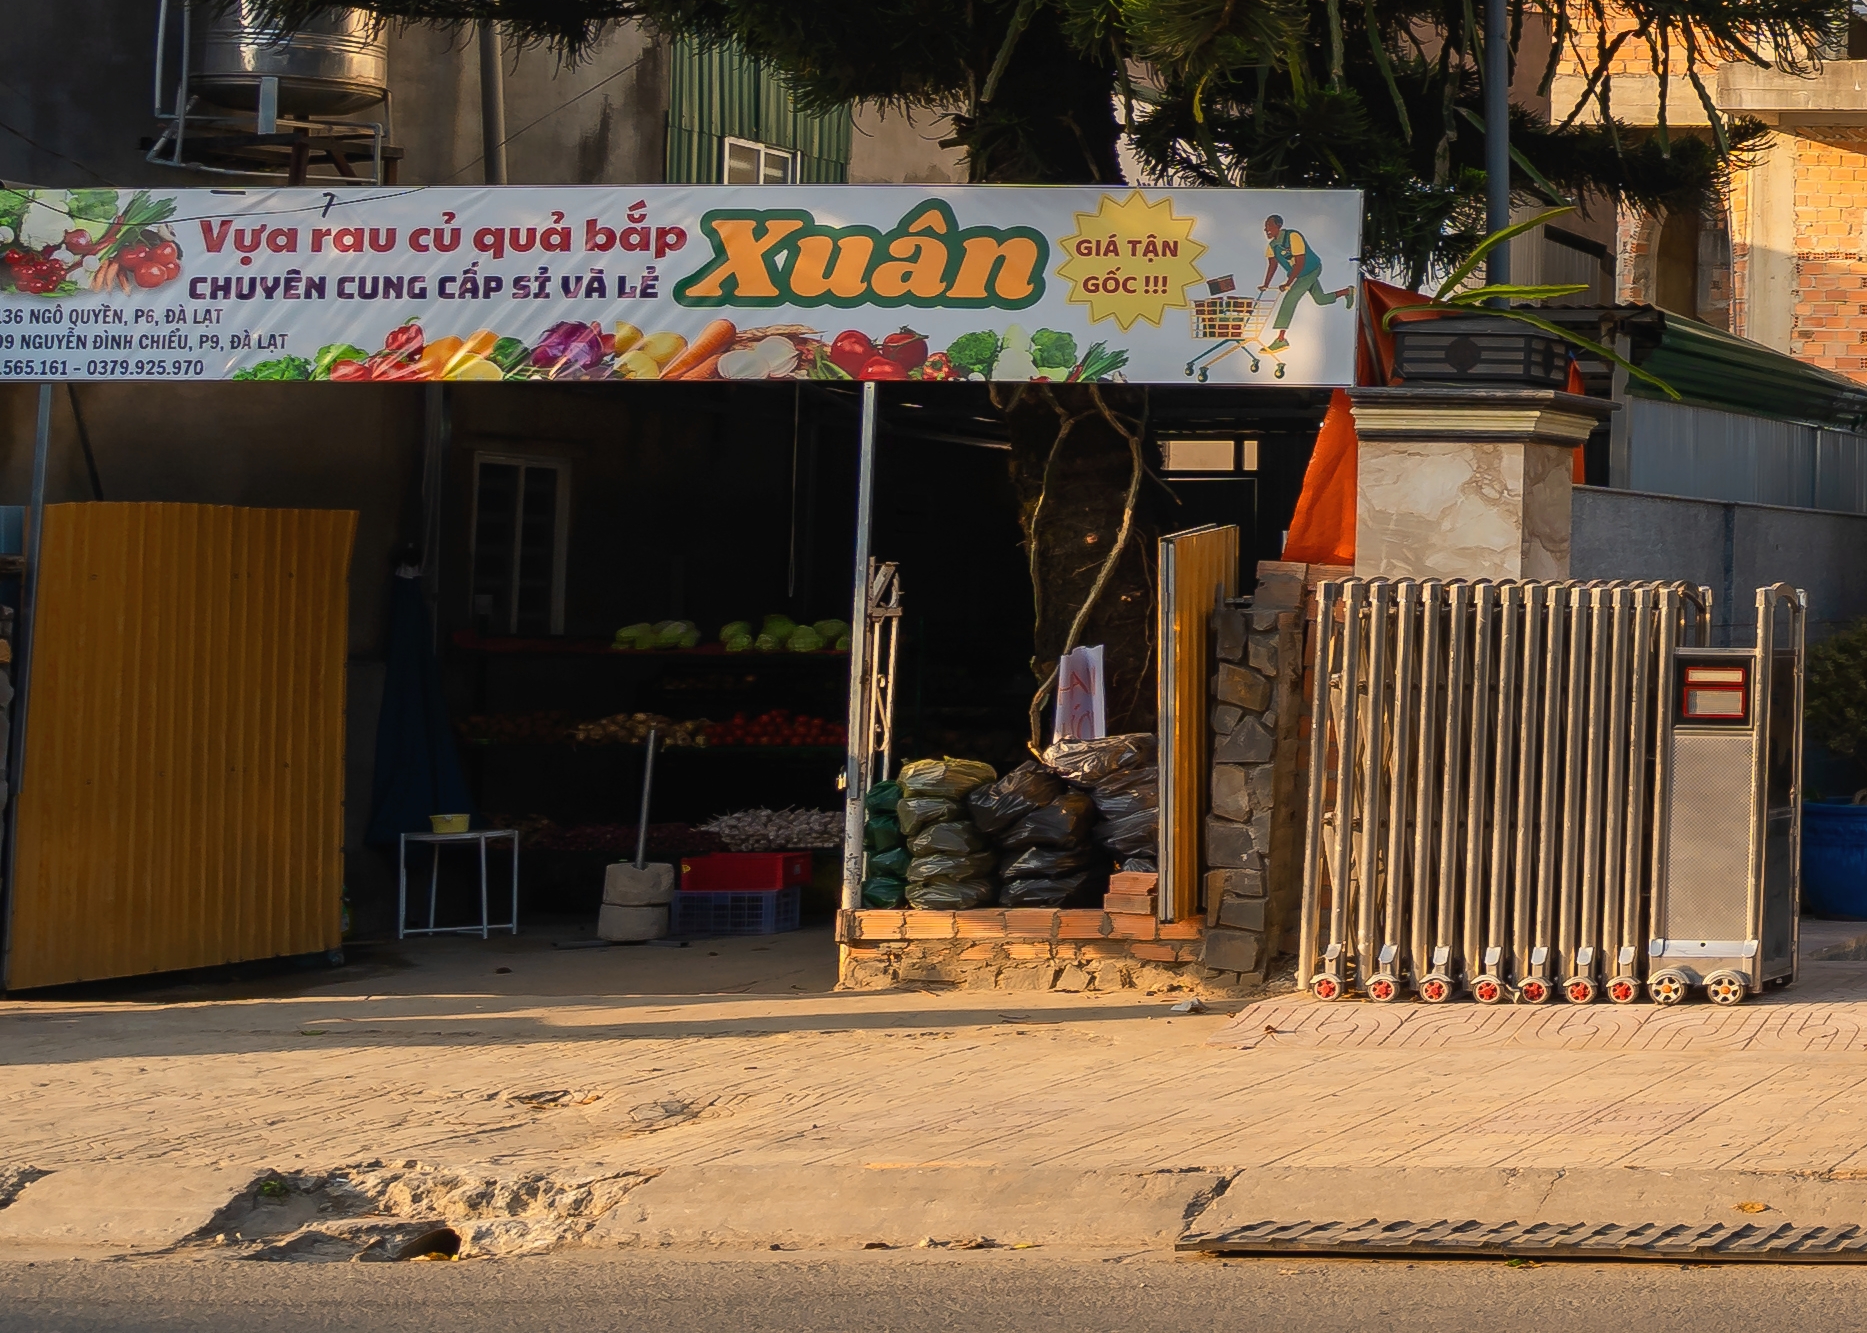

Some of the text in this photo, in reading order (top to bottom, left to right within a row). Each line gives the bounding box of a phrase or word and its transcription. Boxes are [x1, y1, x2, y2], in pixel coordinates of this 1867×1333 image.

[199, 199, 688, 267] Vựa rau củ quả bắp
[685, 208, 1039, 300] Xuân
[1075, 233, 1179, 263] GIÁ TẬN
[188, 268, 327, 301] CHUYÊN
[336, 275, 428, 300] CUNG
[437, 260, 504, 300] CẤP
[616, 265, 660, 299] LẺ
[1082, 266, 1169, 295] GỐC !!!
[0, 303, 224, 328] 36 NGÔ QUYỀN, P6, ĐÀ LẠT
[20, 327, 88, 350] NGUYỄN
[92, 329, 133, 350] ĐÌNH
[138, 327, 193, 352] CHIỂU,
[199, 335, 224, 351] P9,
[230, 329, 252, 350] ĐÀ
[257, 334, 288, 353] LẠT
[86, 359, 205, 376] 0379.925.970
